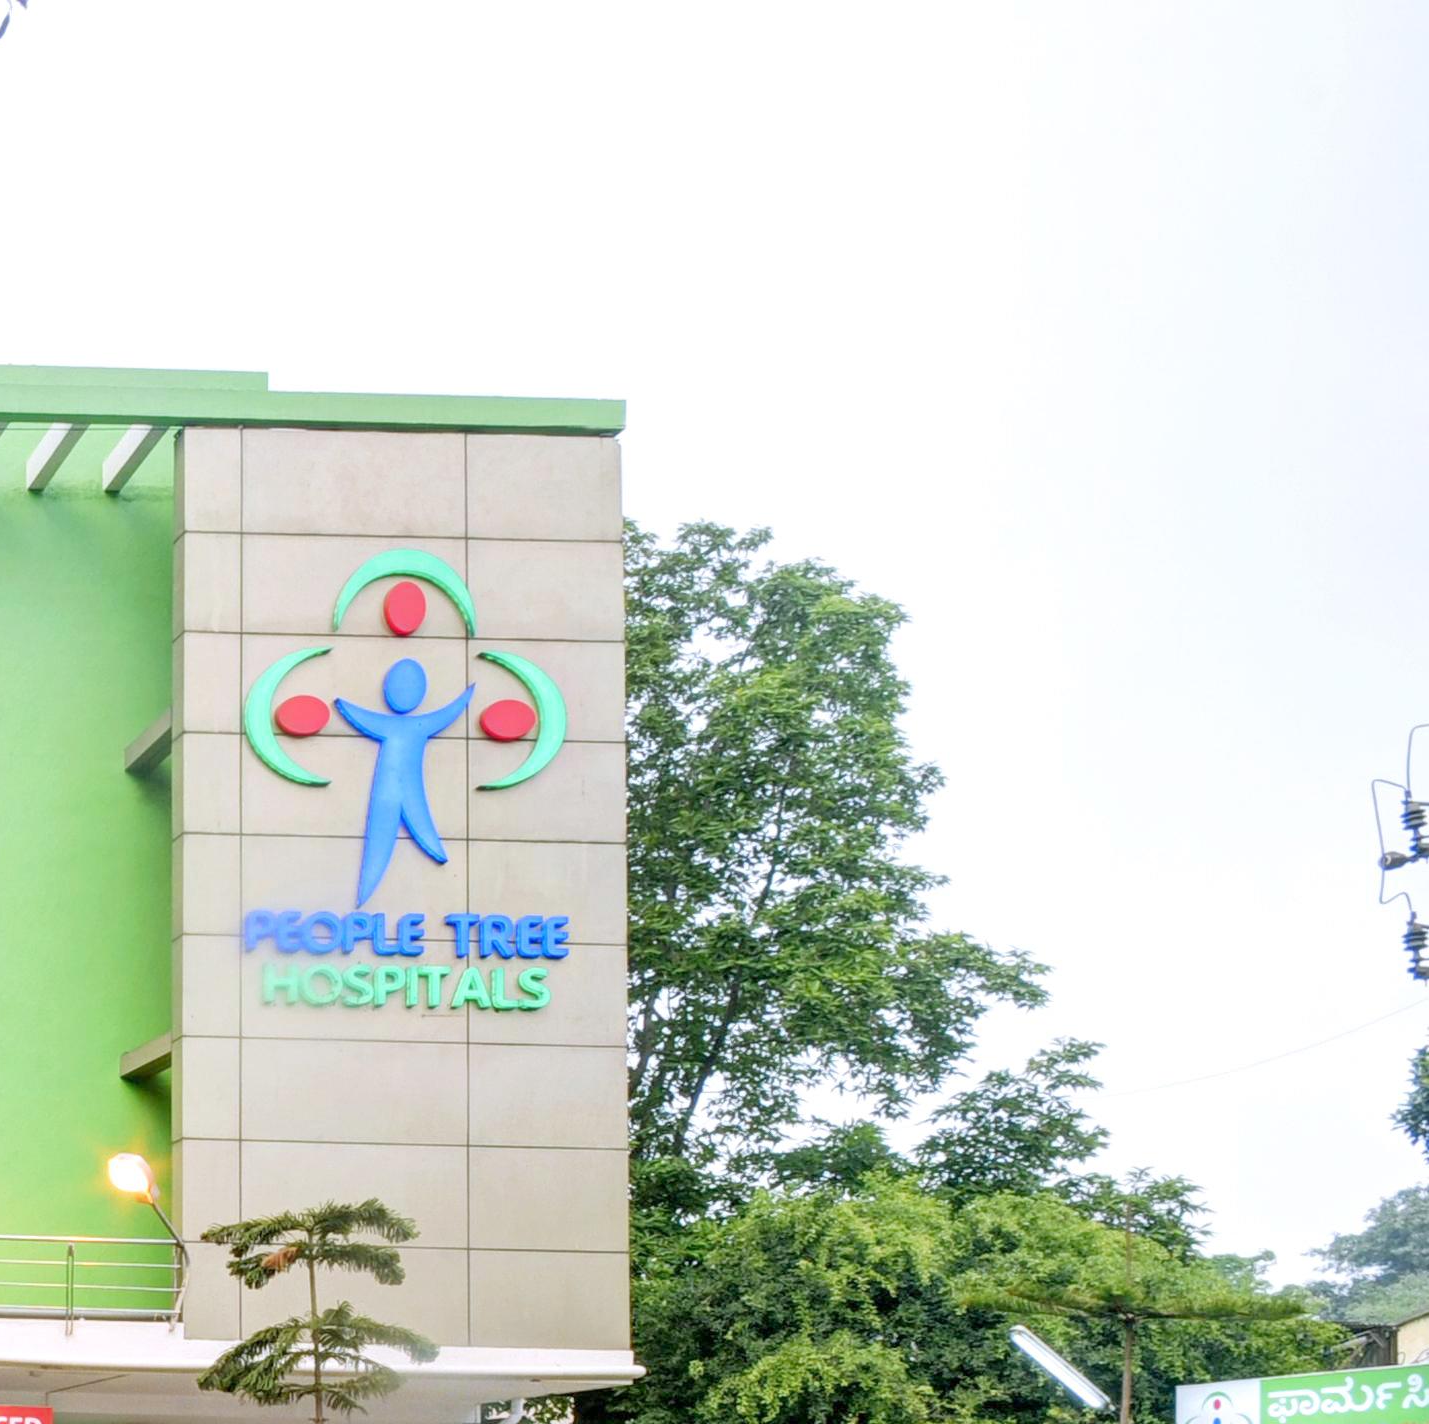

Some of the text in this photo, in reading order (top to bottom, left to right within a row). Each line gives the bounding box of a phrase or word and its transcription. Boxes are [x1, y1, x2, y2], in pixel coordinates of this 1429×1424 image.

[244, 910, 569, 959] PEOPLE TREE
[261, 963, 552, 1011] HOSPITALS
